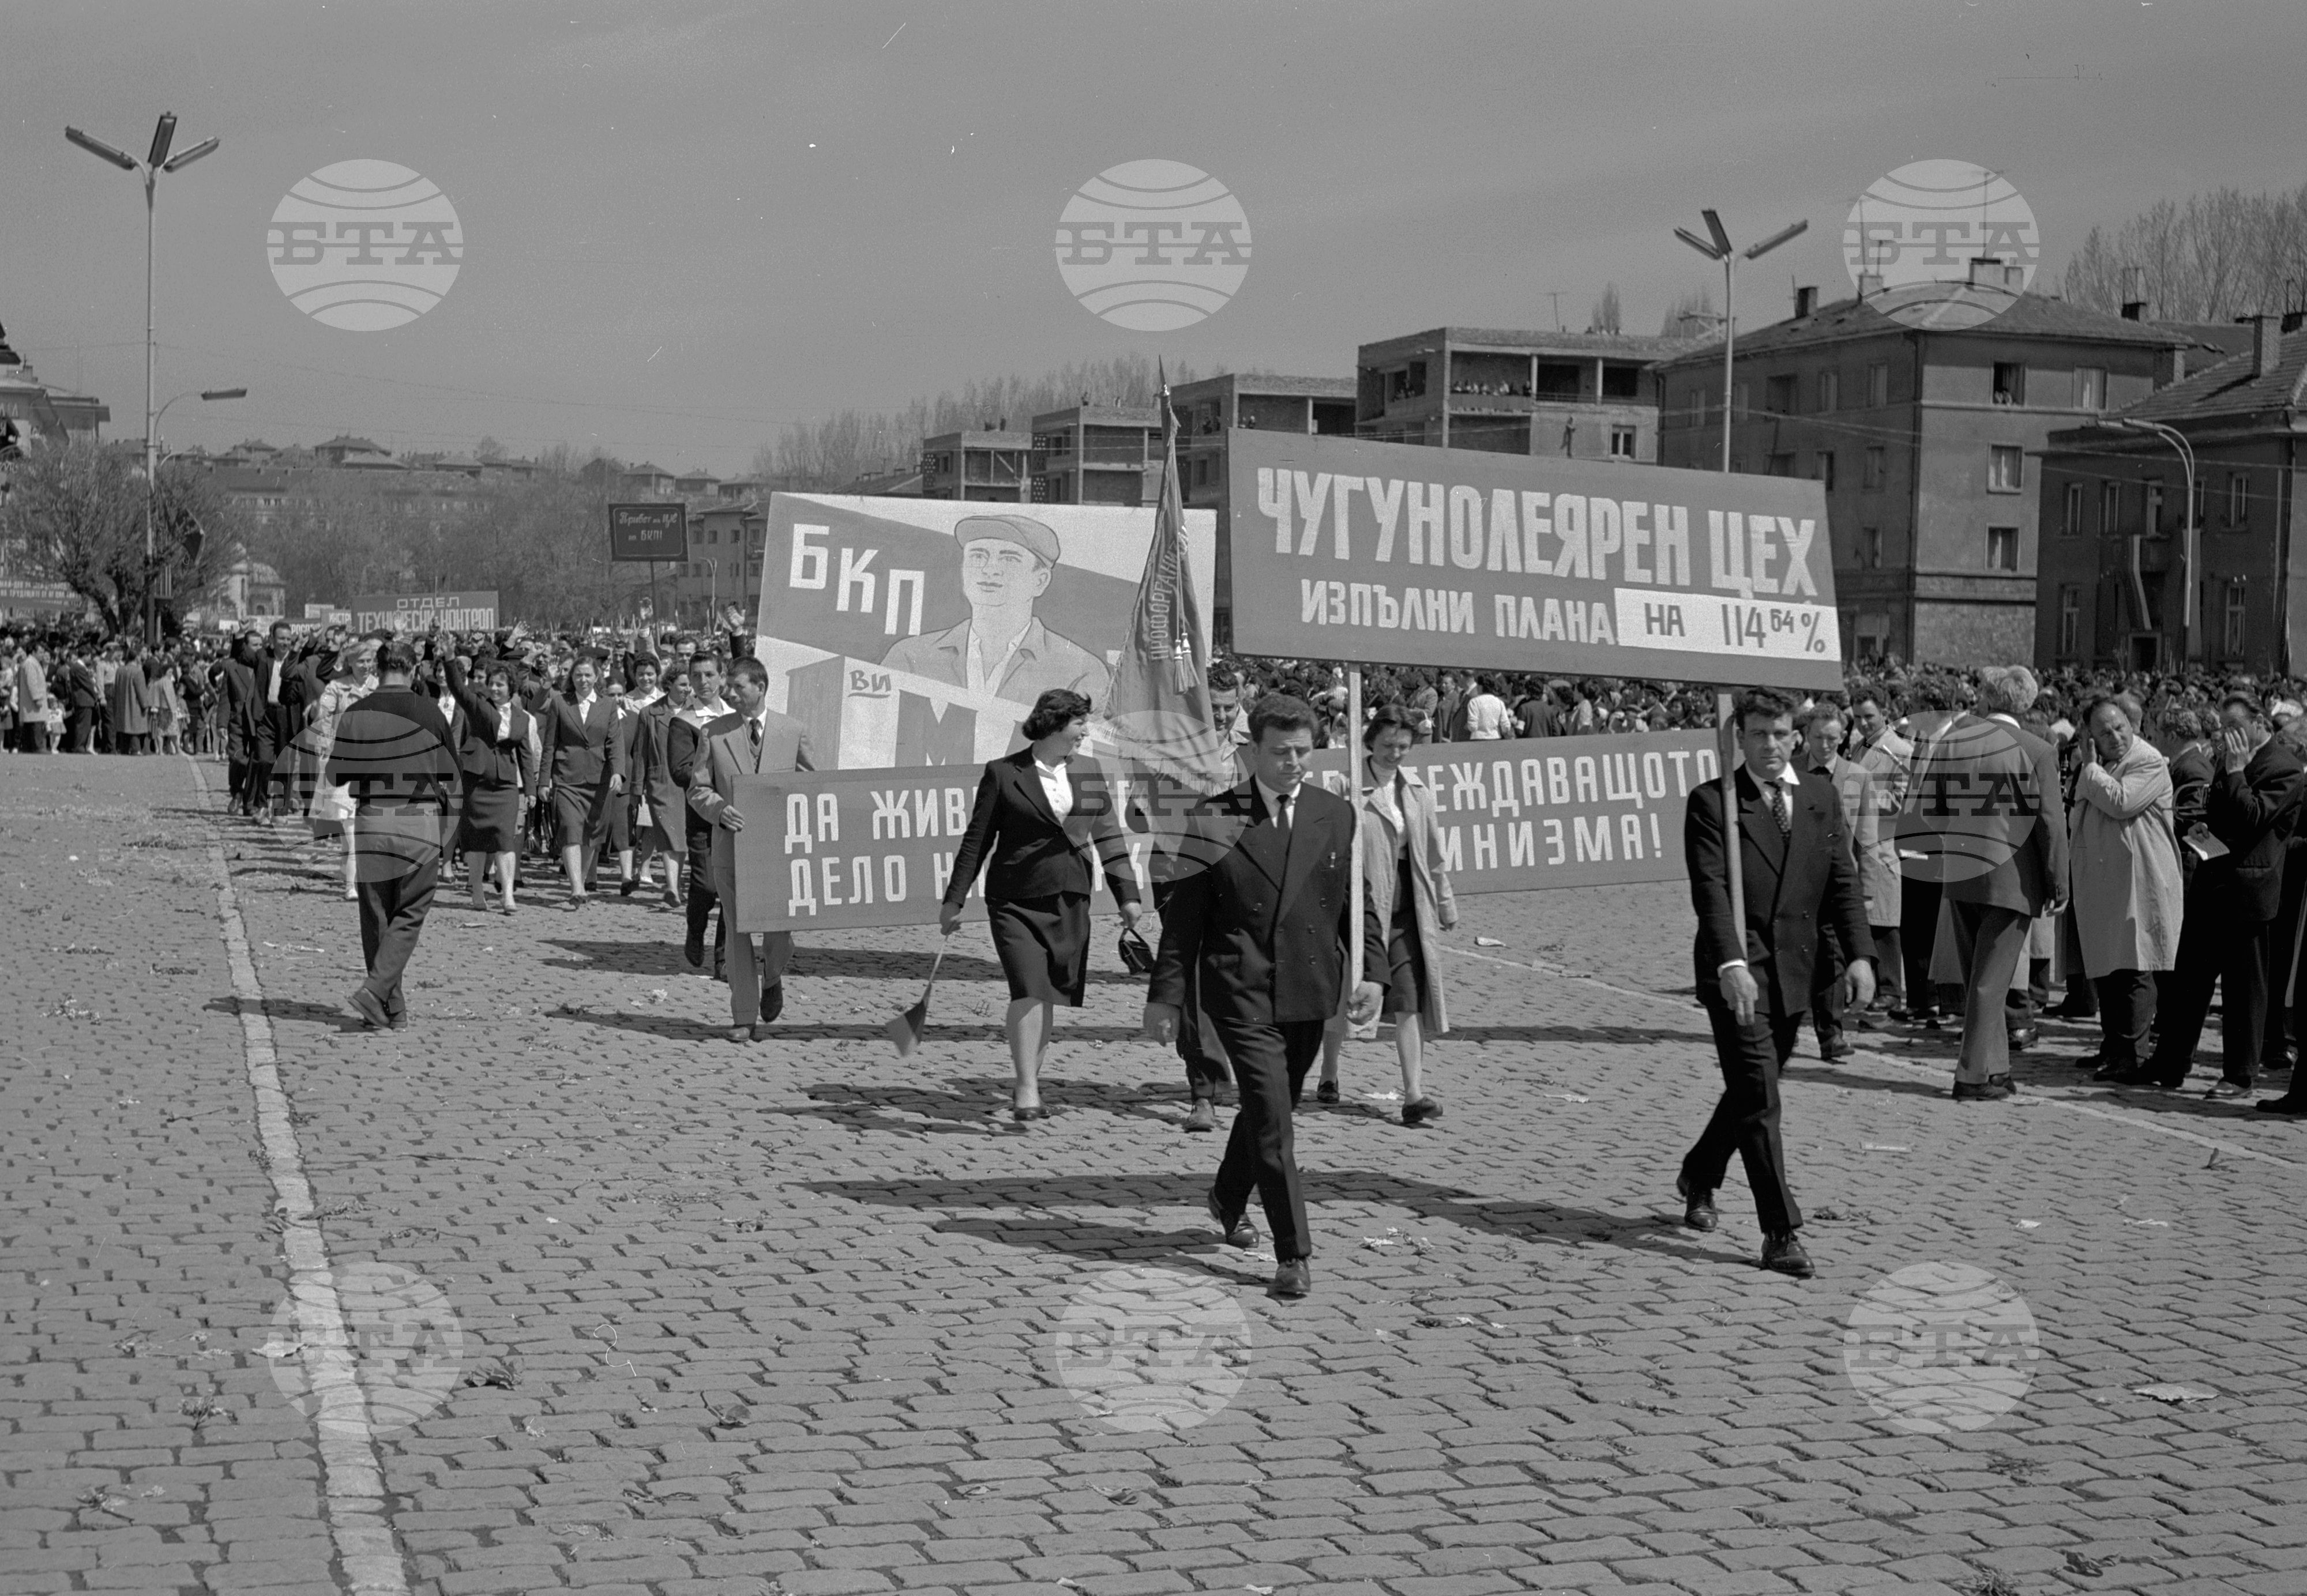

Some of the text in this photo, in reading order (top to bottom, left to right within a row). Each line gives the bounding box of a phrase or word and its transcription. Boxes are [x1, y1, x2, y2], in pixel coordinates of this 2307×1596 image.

[1257, 467, 1818, 600] ЧУГУНОЛЕЯРЕН ЦЕХ
[397, 596, 460, 610] ОТДЕЛ
[789, 523, 925, 635] БКП
[1301, 578, 1475, 635] ИЗПЪЛНИ
[1495, 594, 1615, 646] ПЛАНА
[1644, 602, 1686, 637] НА
[784, 749, 1719, 855] ДА ЖИВ ЕЖДАВАЩОТО
[788, 855, 907, 917] ДЕЛО
